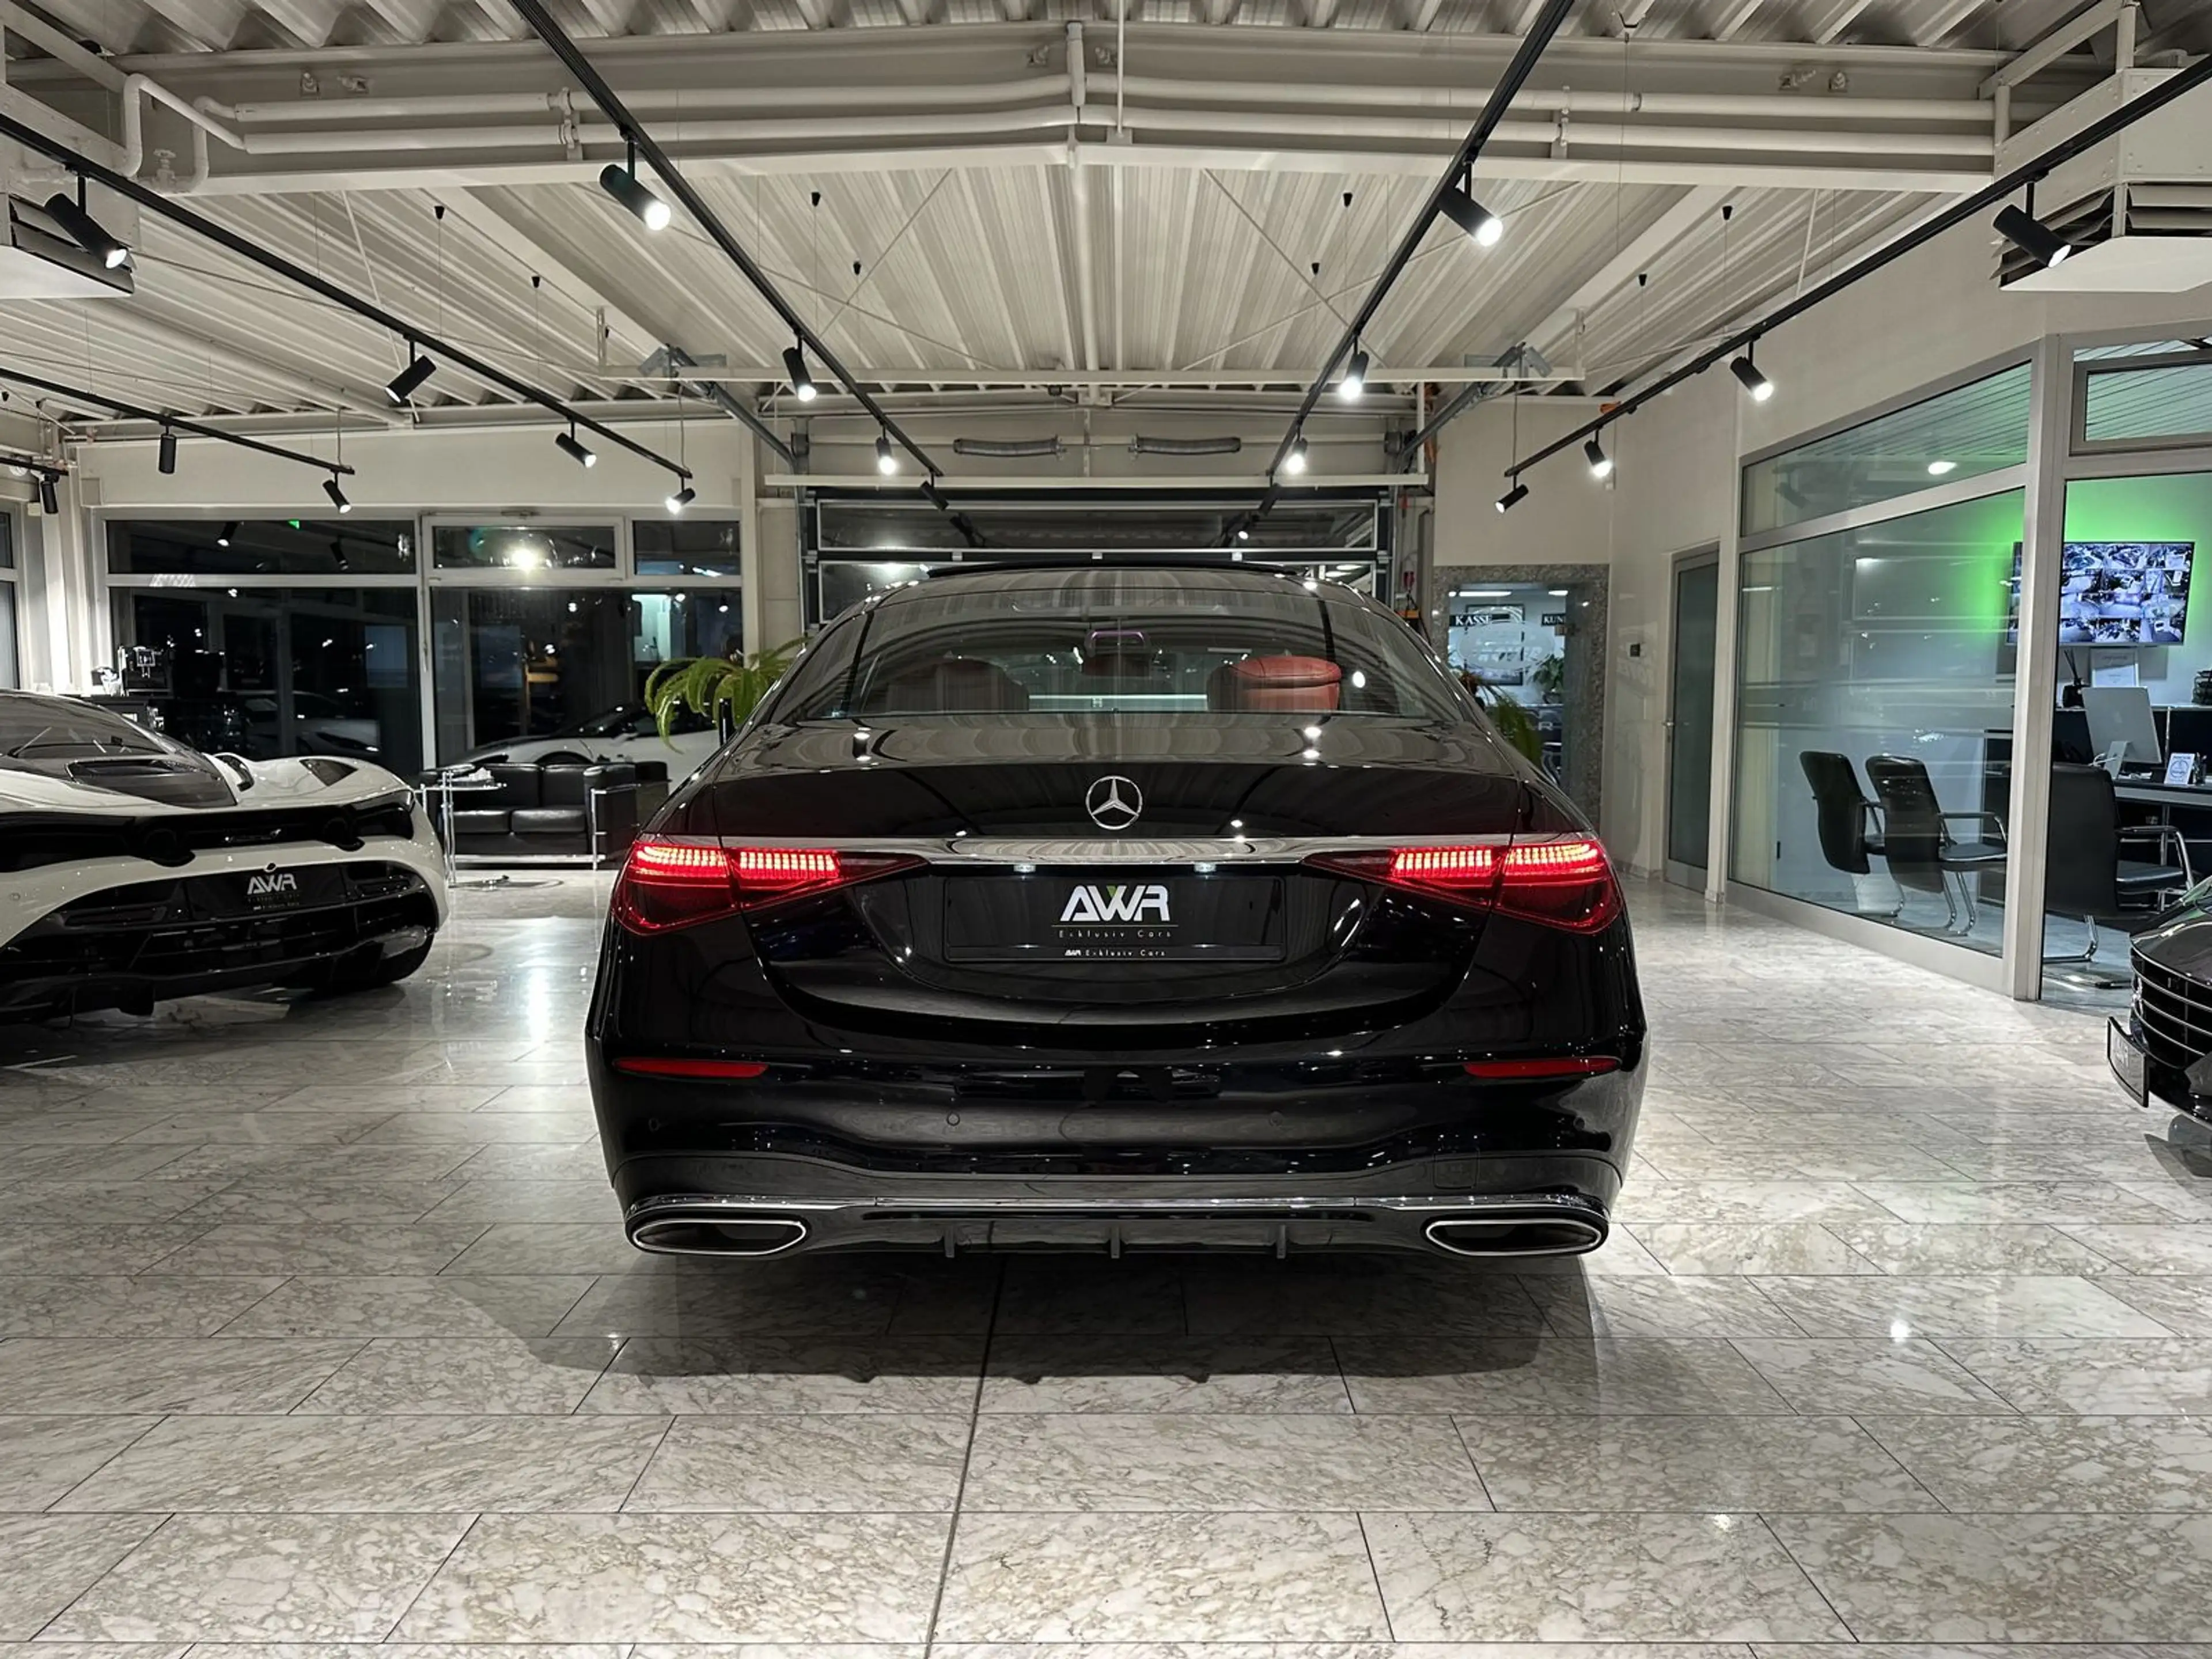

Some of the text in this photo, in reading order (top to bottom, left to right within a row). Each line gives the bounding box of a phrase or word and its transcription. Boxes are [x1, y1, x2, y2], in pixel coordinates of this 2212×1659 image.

[247, 873, 297, 895] AWR
[1059, 885, 1171, 922] AWR
[1059, 929, 1171, 938] Exklusiv Cars
